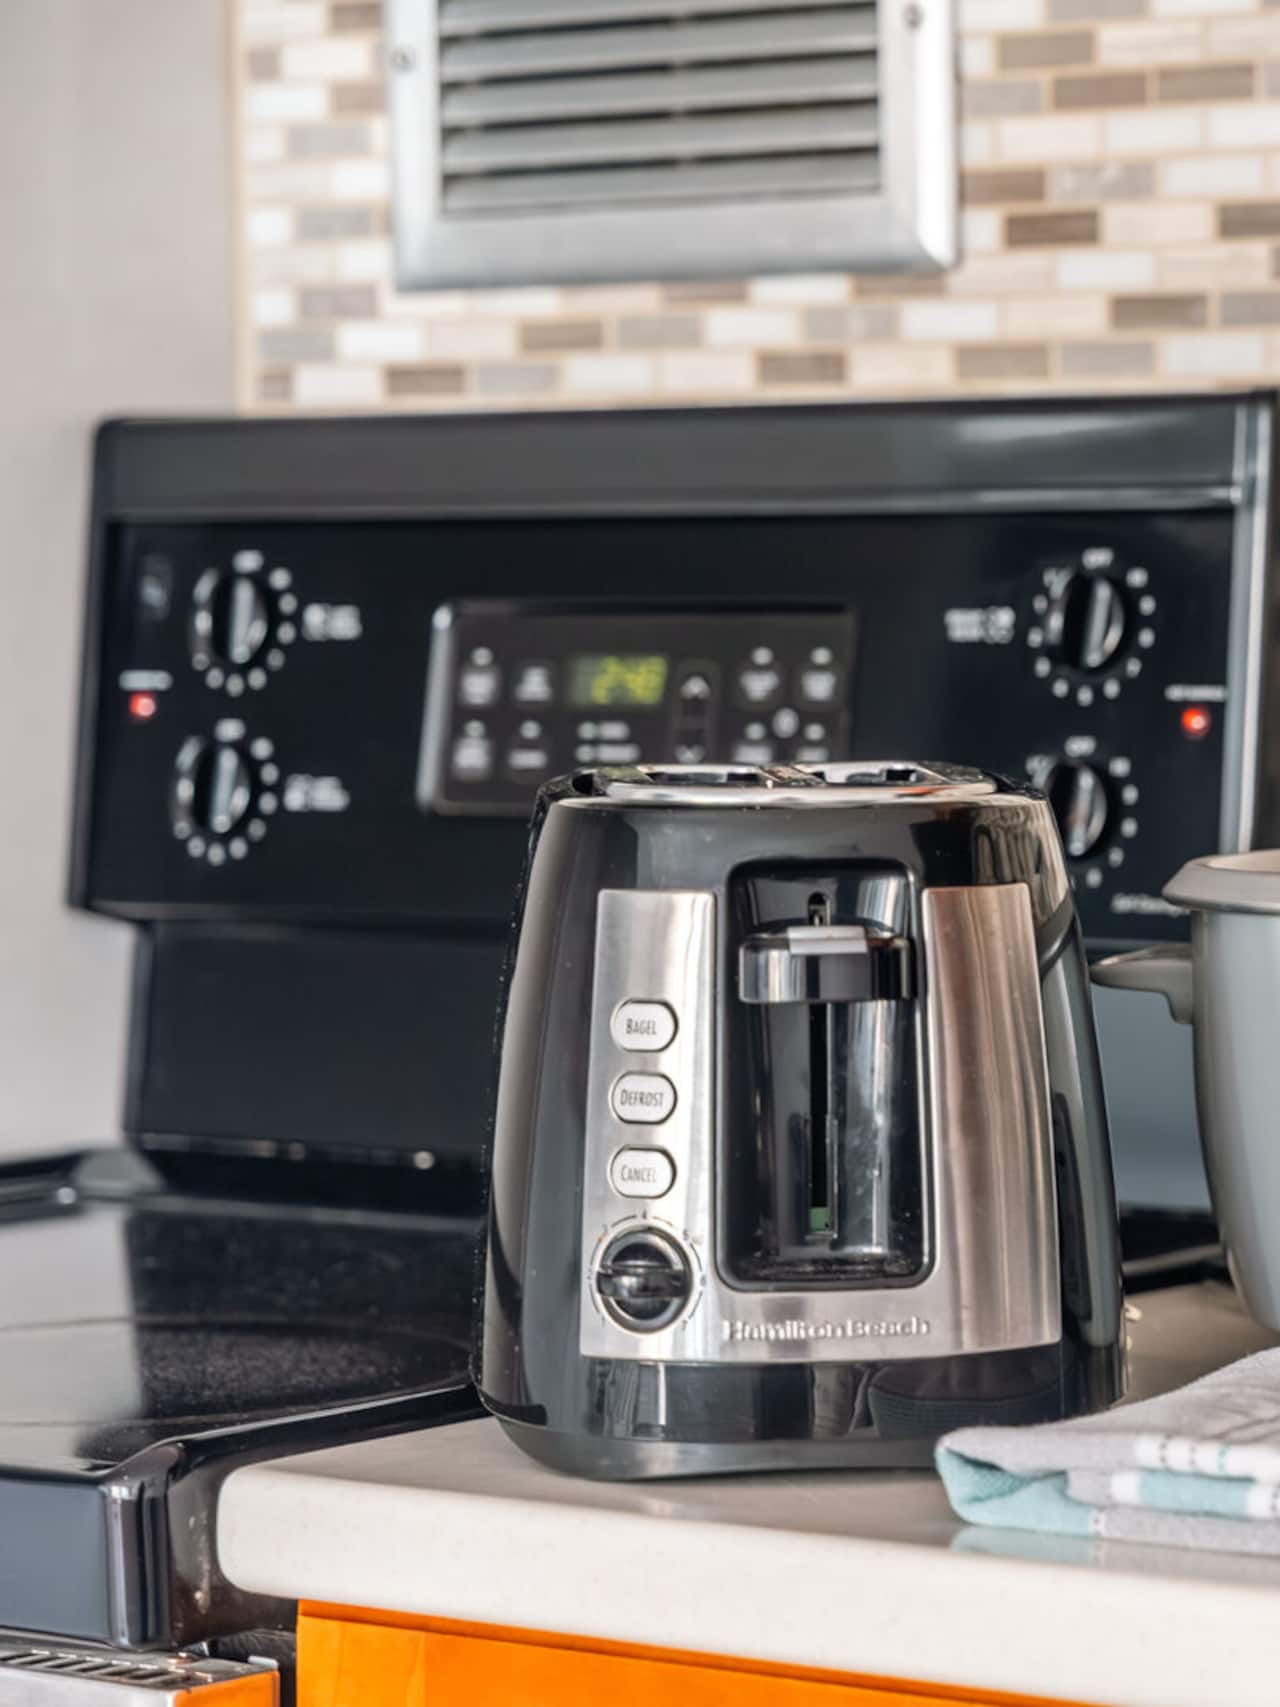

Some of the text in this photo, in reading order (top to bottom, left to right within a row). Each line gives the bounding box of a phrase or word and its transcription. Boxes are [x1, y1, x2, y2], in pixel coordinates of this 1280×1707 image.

[627, 1019, 657, 1035] BAGEL
[620, 1090, 663, 1106] DEFROST
[621, 1167, 656, 1182] CANCEL
[722, 1316, 931, 1341] Hamilton Beach
